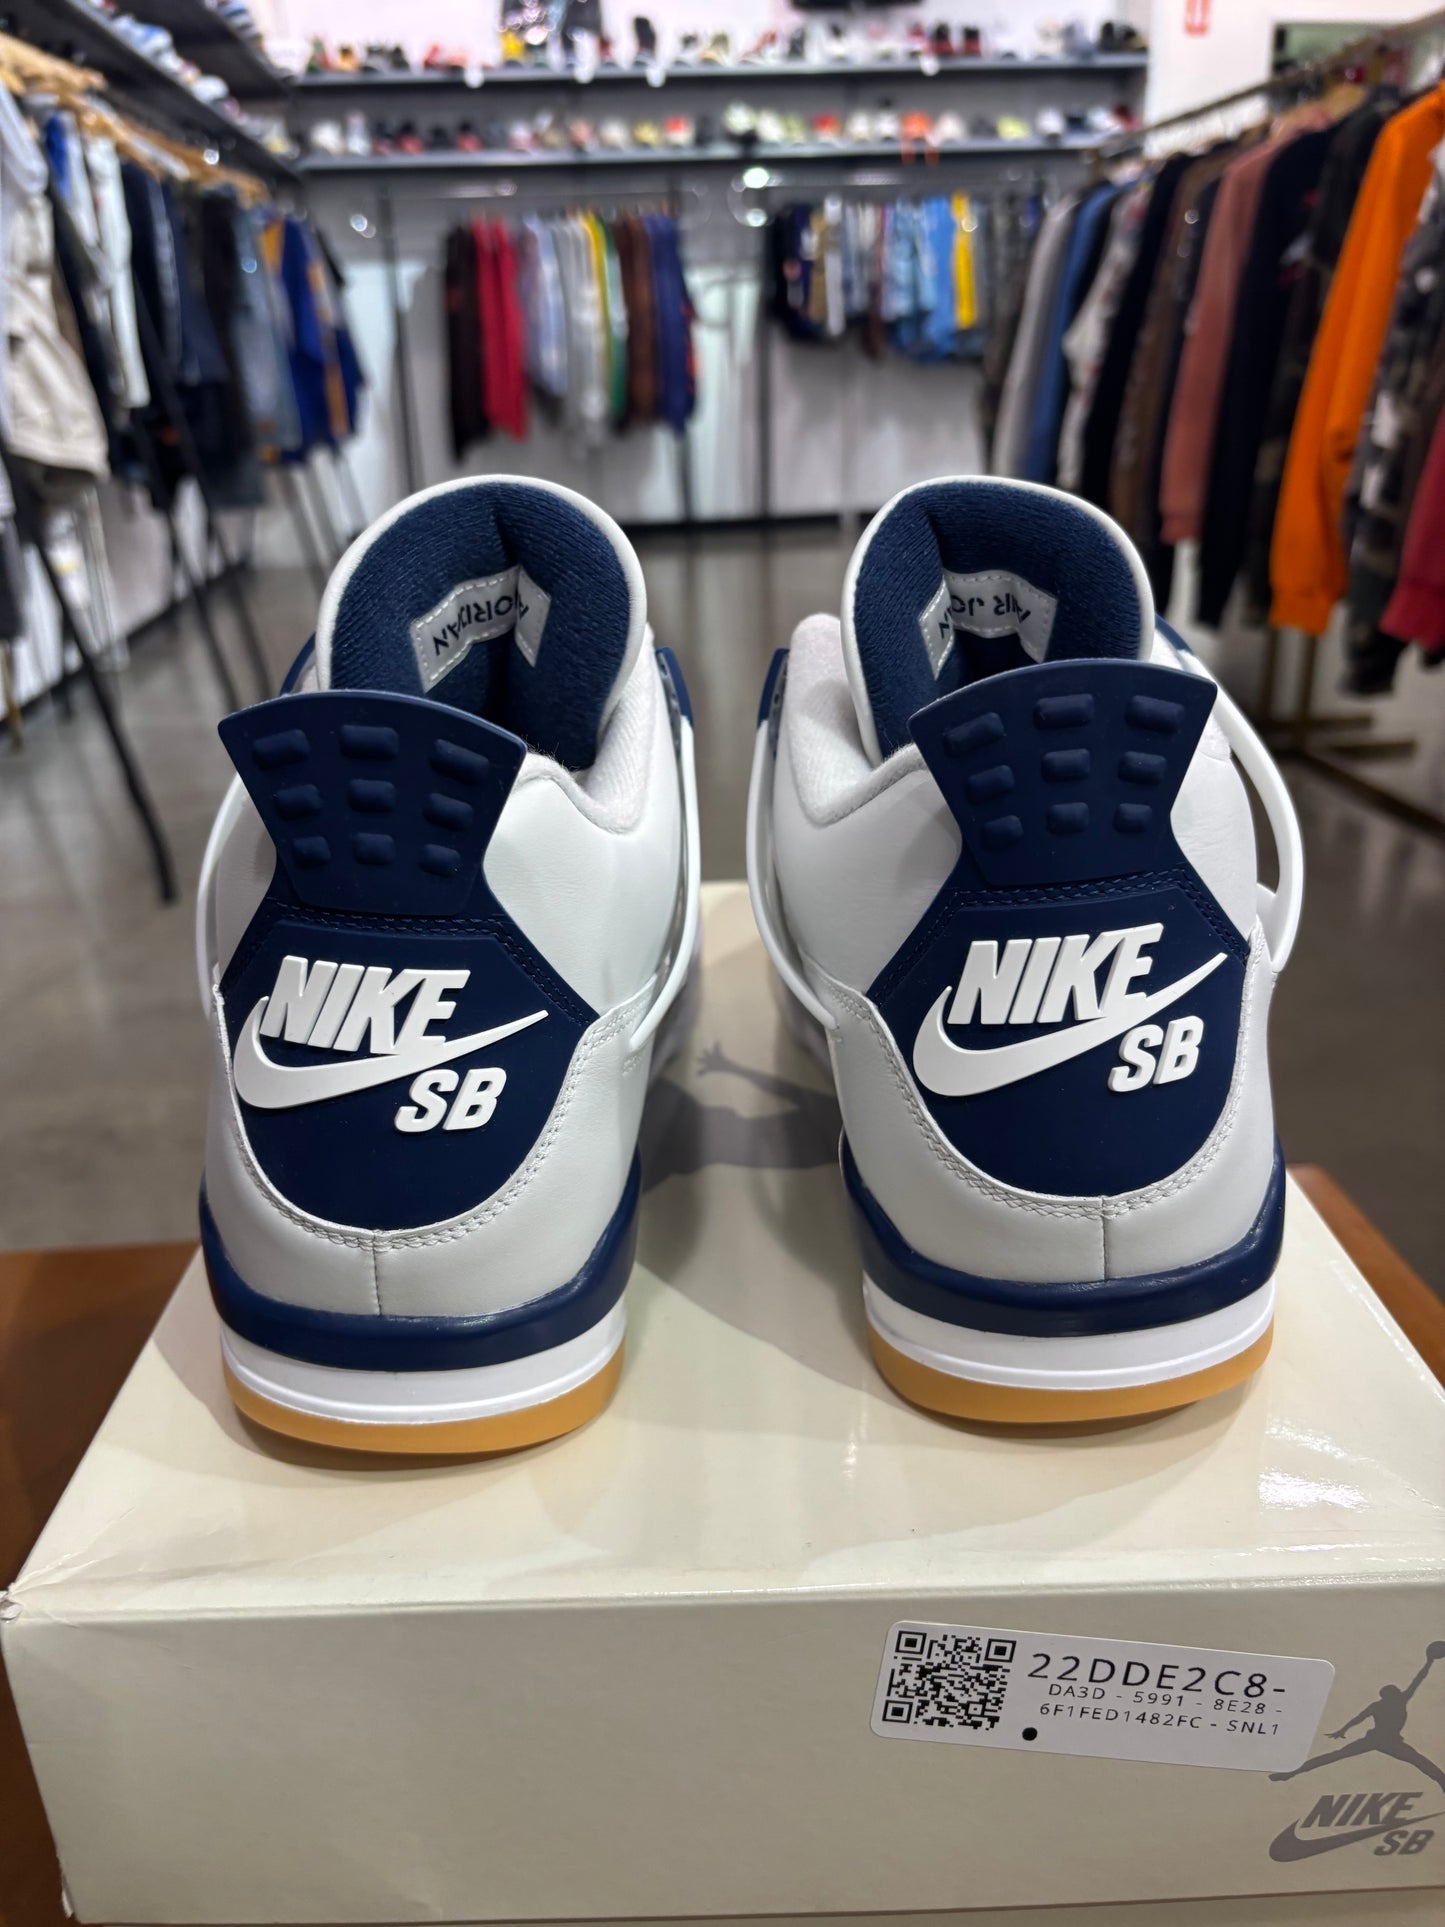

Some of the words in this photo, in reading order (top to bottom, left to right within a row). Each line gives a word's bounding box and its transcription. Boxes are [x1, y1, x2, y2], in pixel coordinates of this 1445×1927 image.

[947, 922, 1164, 1024] NIKE
[259, 955, 471, 1056] NIKE
[1107, 1015, 1204, 1093] SB
[394, 1067, 507, 1133] SB
[1027, 1652, 1286, 1699] 22DDE2C8-
[1048, 1683, 1106, 1700] DA3D
[1132, 1690, 1184, 1707] 5991
[1213, 1698, 1266, 1715] 8E28
[1039, 1703, 1203, 1729] 6F1FED1482FC
[1226, 1719, 1279, 1736] SNL1
[1300, 1791, 1424, 1829] NIKE
[1373, 1829, 1435, 1856] SB
